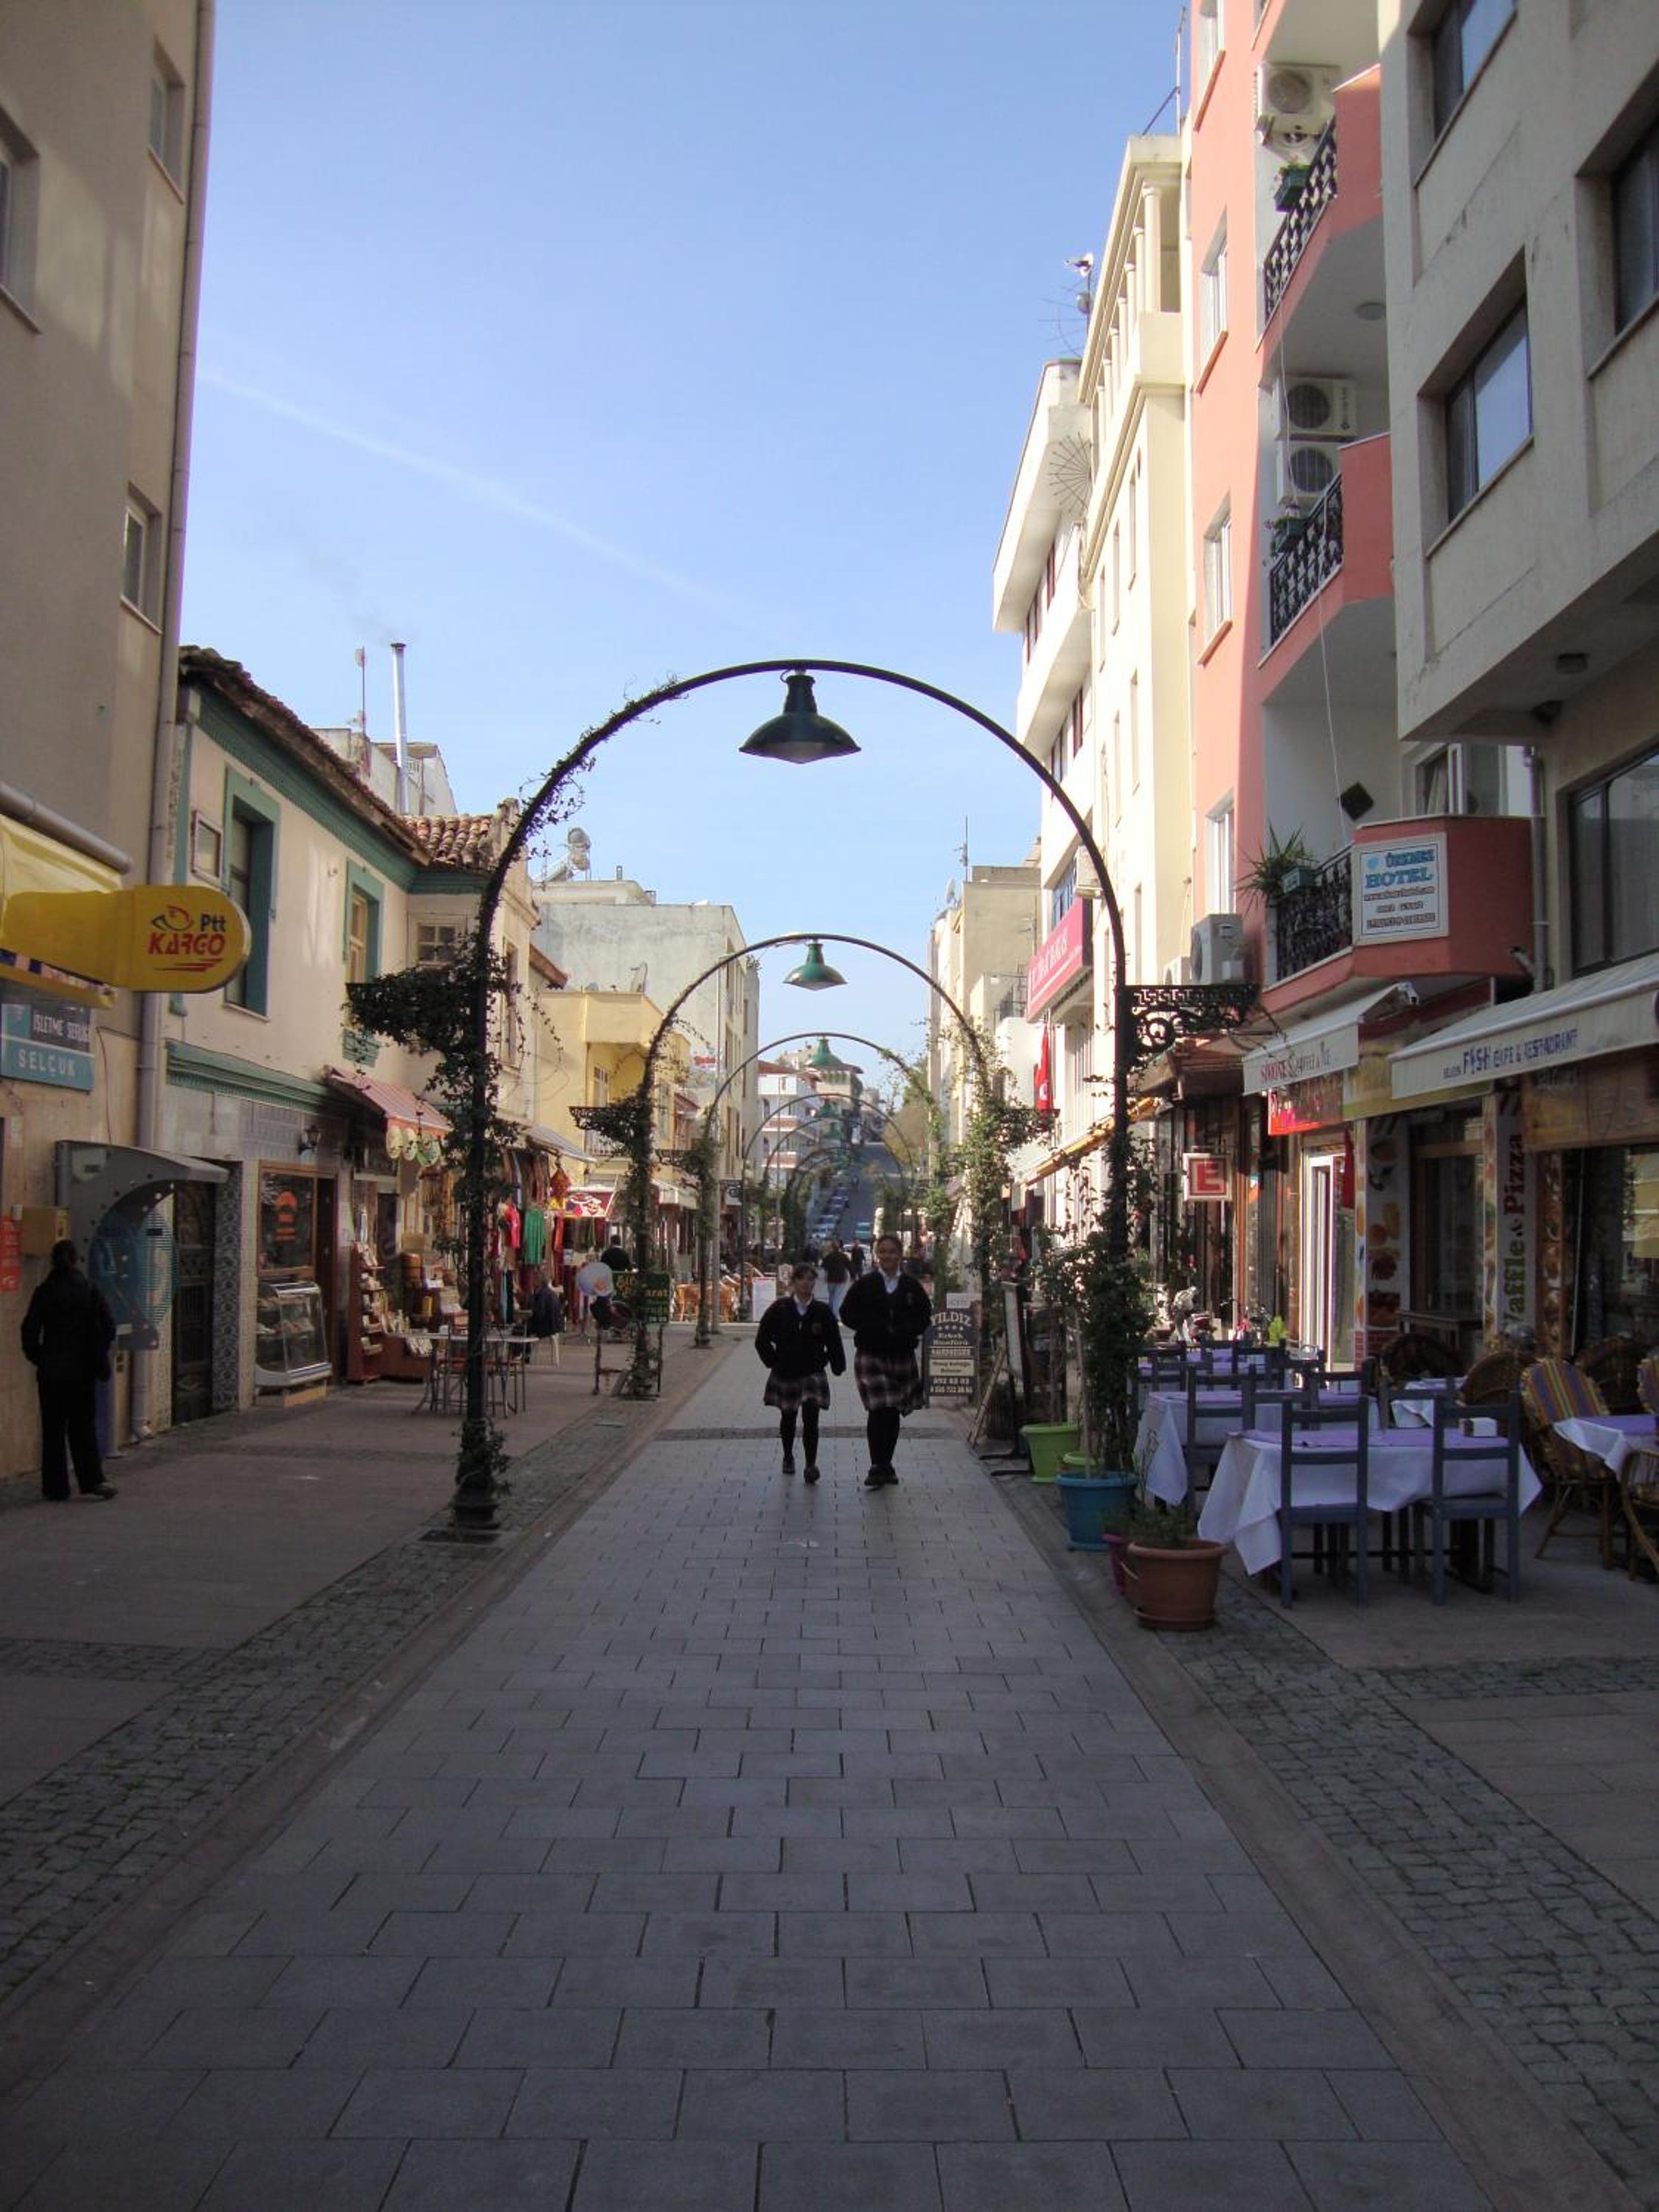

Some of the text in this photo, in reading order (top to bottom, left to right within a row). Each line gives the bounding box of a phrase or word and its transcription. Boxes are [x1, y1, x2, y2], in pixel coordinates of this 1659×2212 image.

[1365, 867, 1433, 888] HOTEL
[200, 914, 226, 932] Ptt
[147, 933, 226, 955] KARGO
[1503, 1135, 1526, 1216] Pizza
[931, 1312, 972, 1326] YILDIZ
